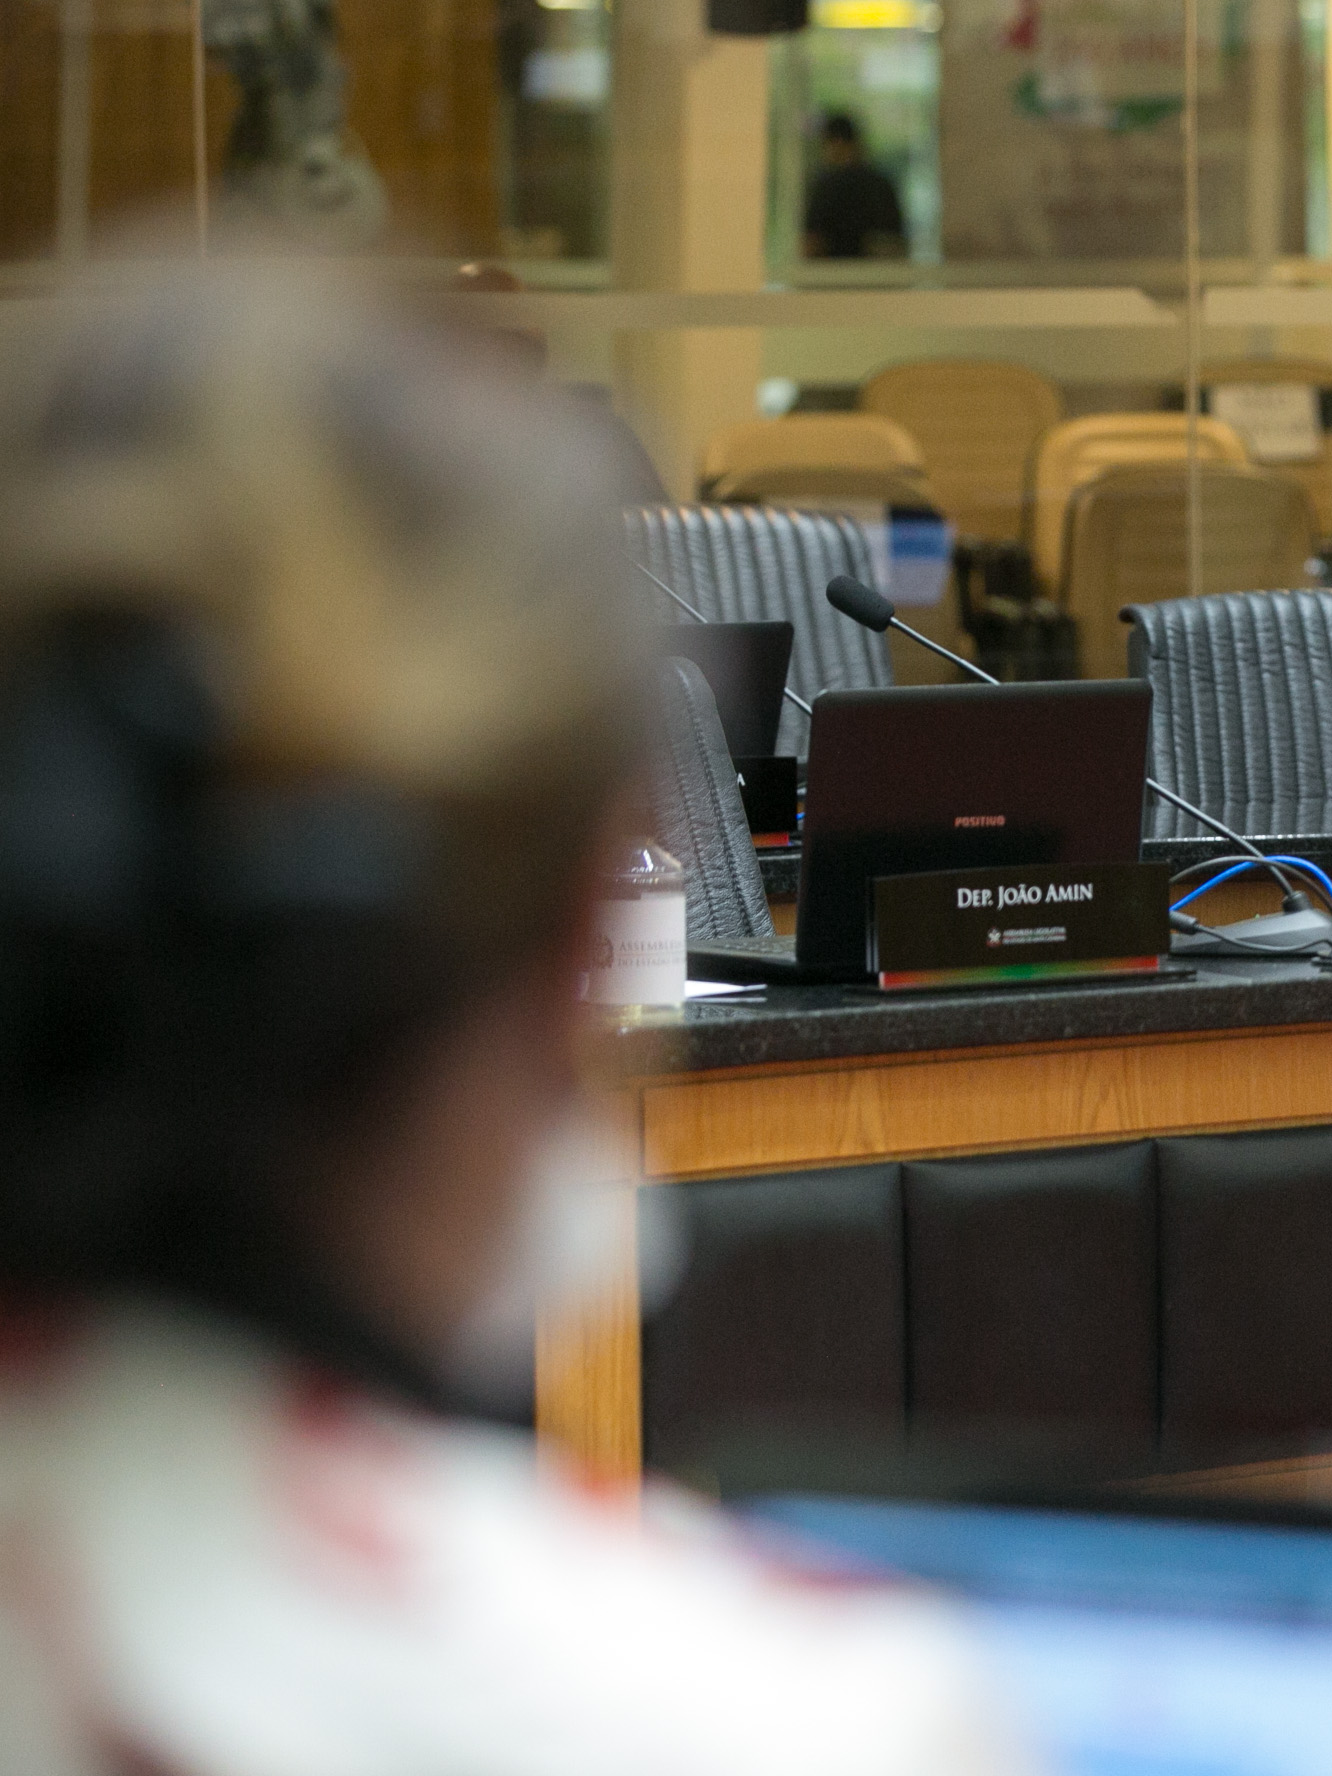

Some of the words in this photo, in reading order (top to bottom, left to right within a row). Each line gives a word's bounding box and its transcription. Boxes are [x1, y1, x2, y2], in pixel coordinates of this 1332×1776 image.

[954, 815, 1005, 827] POSITIVO
[957, 887, 993, 909] DEP.
[997, 883, 1042, 910] JOÃO
[1045, 883, 1093, 902] AMIN
